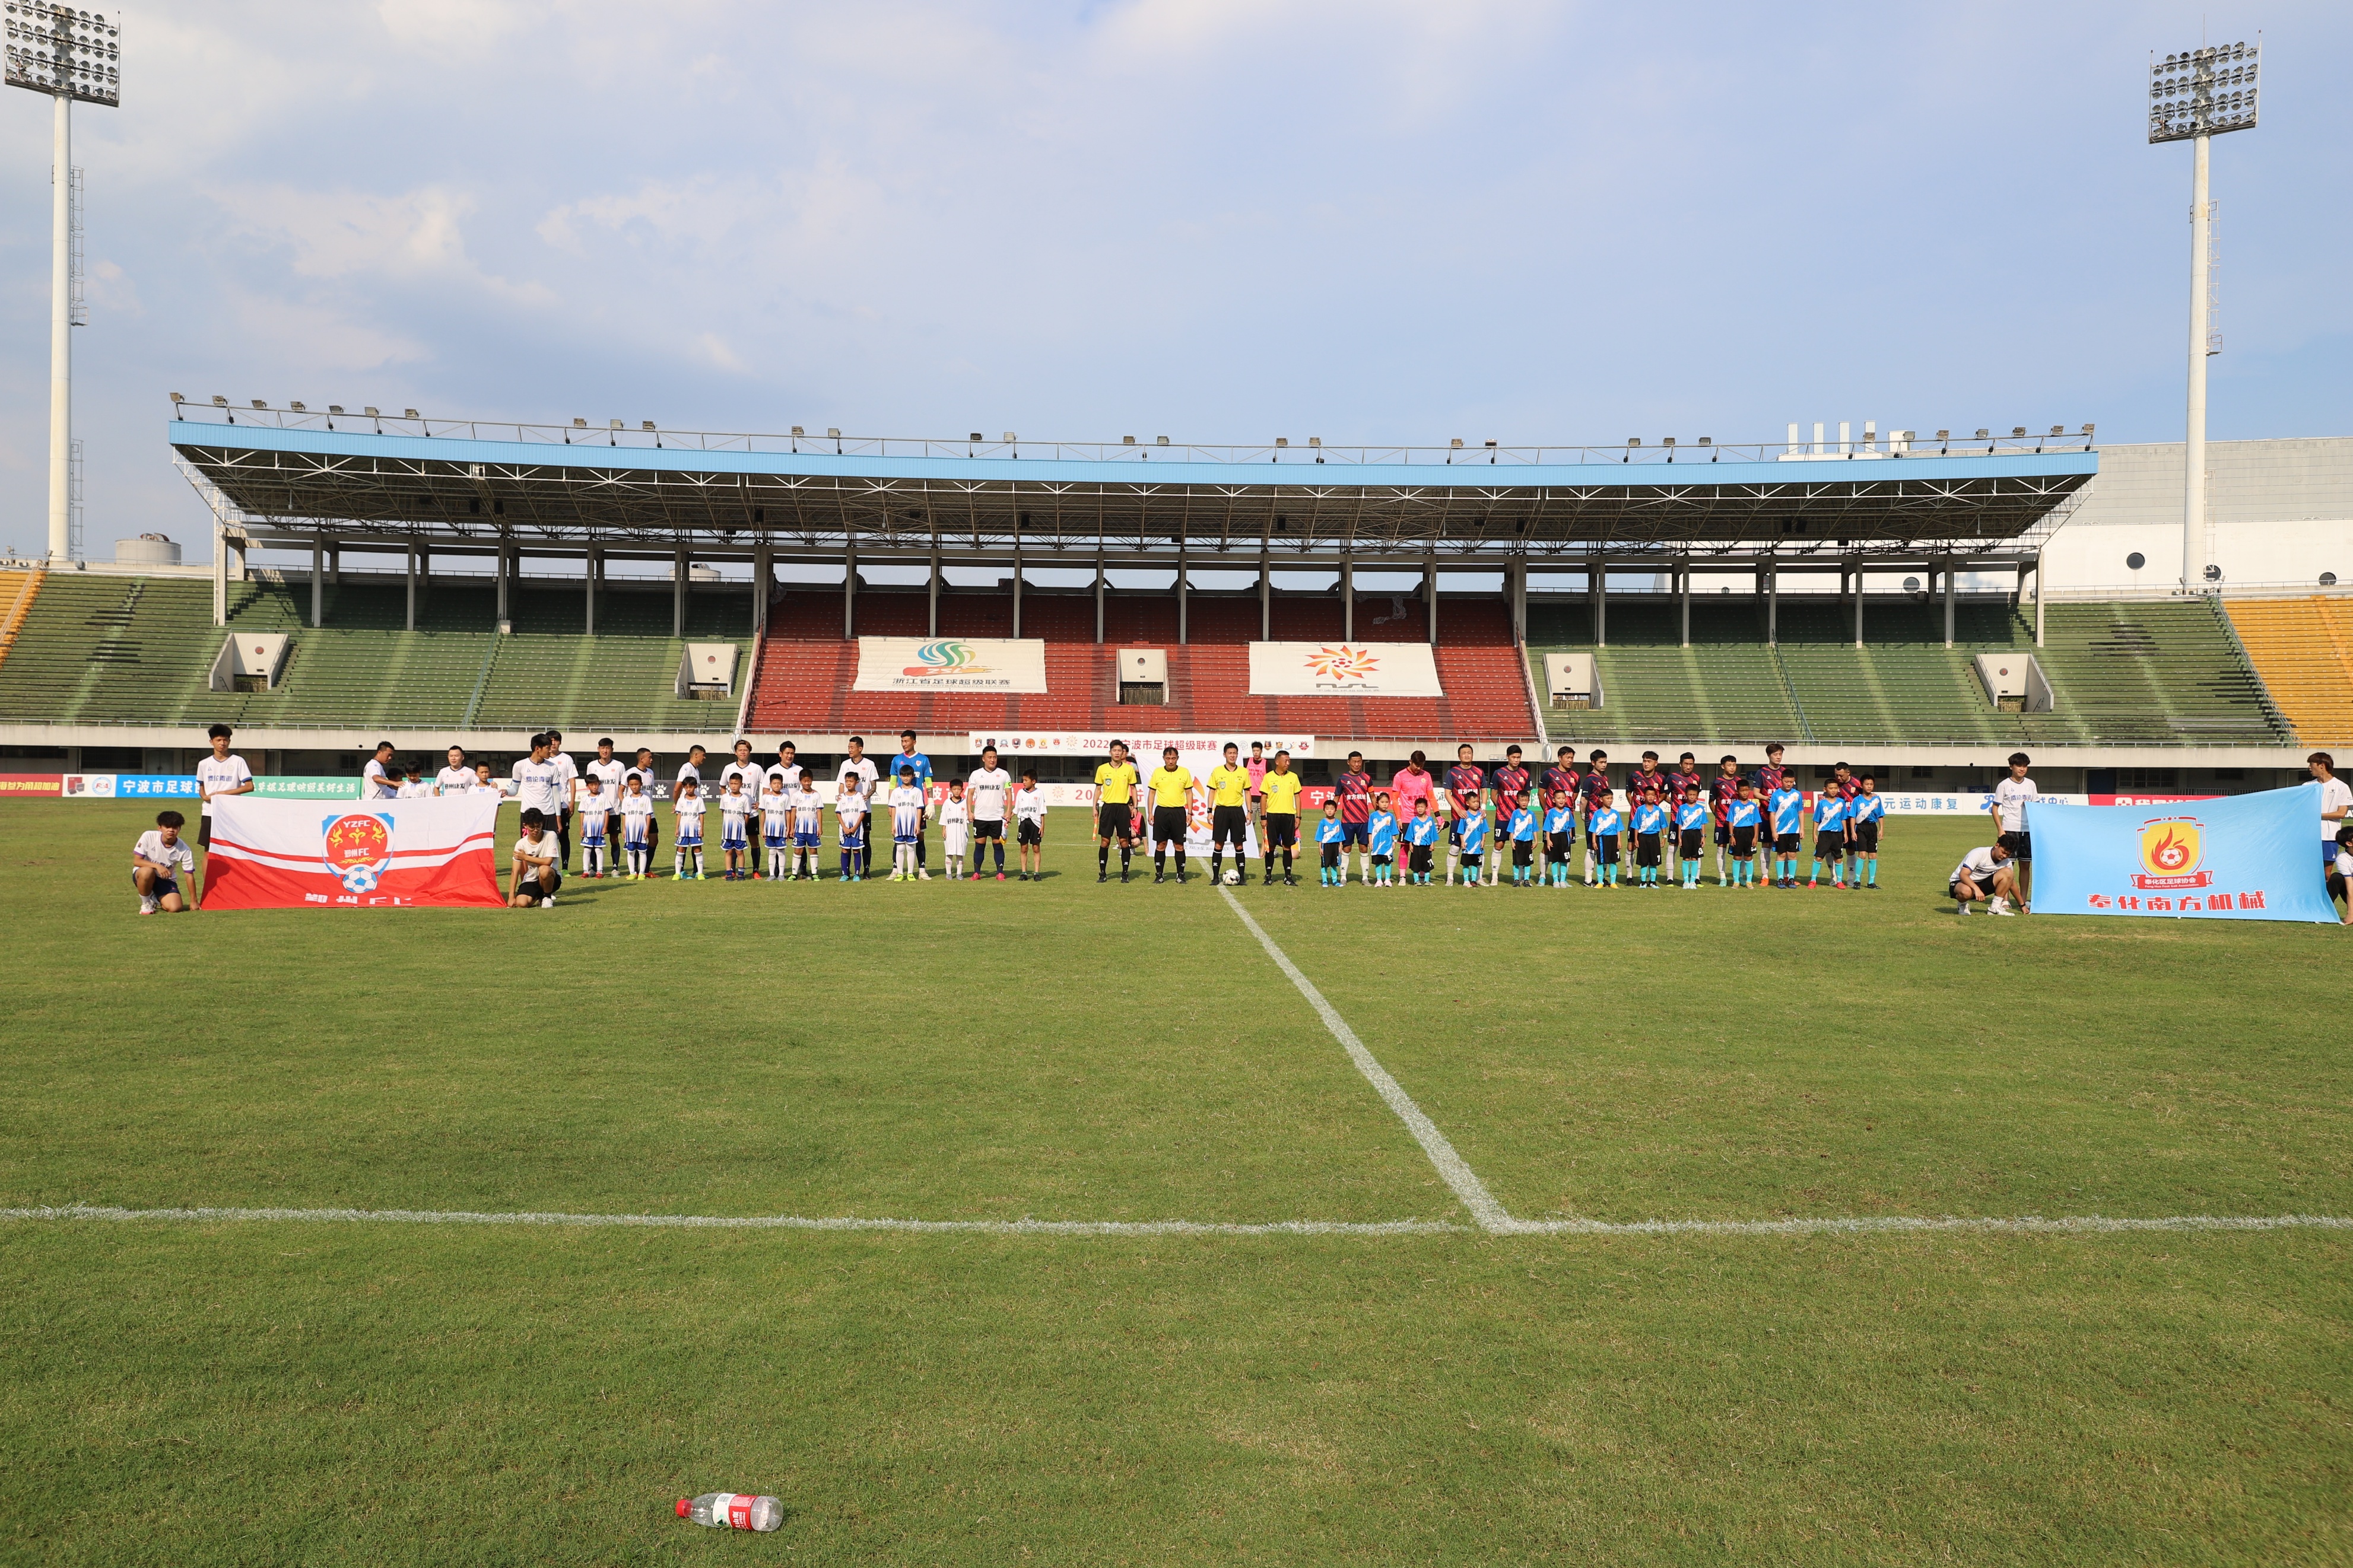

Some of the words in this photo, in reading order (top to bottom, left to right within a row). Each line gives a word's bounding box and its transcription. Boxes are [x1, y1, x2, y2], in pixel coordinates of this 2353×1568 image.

[1083, 739, 1217, 751] 2022宁波市足球超级联赛
[253, 781, 355, 793] 草根足球映照美好生活
[343, 820, 371, 828] YZFC
[1495, 828, 1501, 838] 37
[344, 847, 370, 858] 鄞州FC
[2144, 877, 2196, 885] 奉化区足球协会
[2088, 890, 2266, 911] 奉化南方机械
